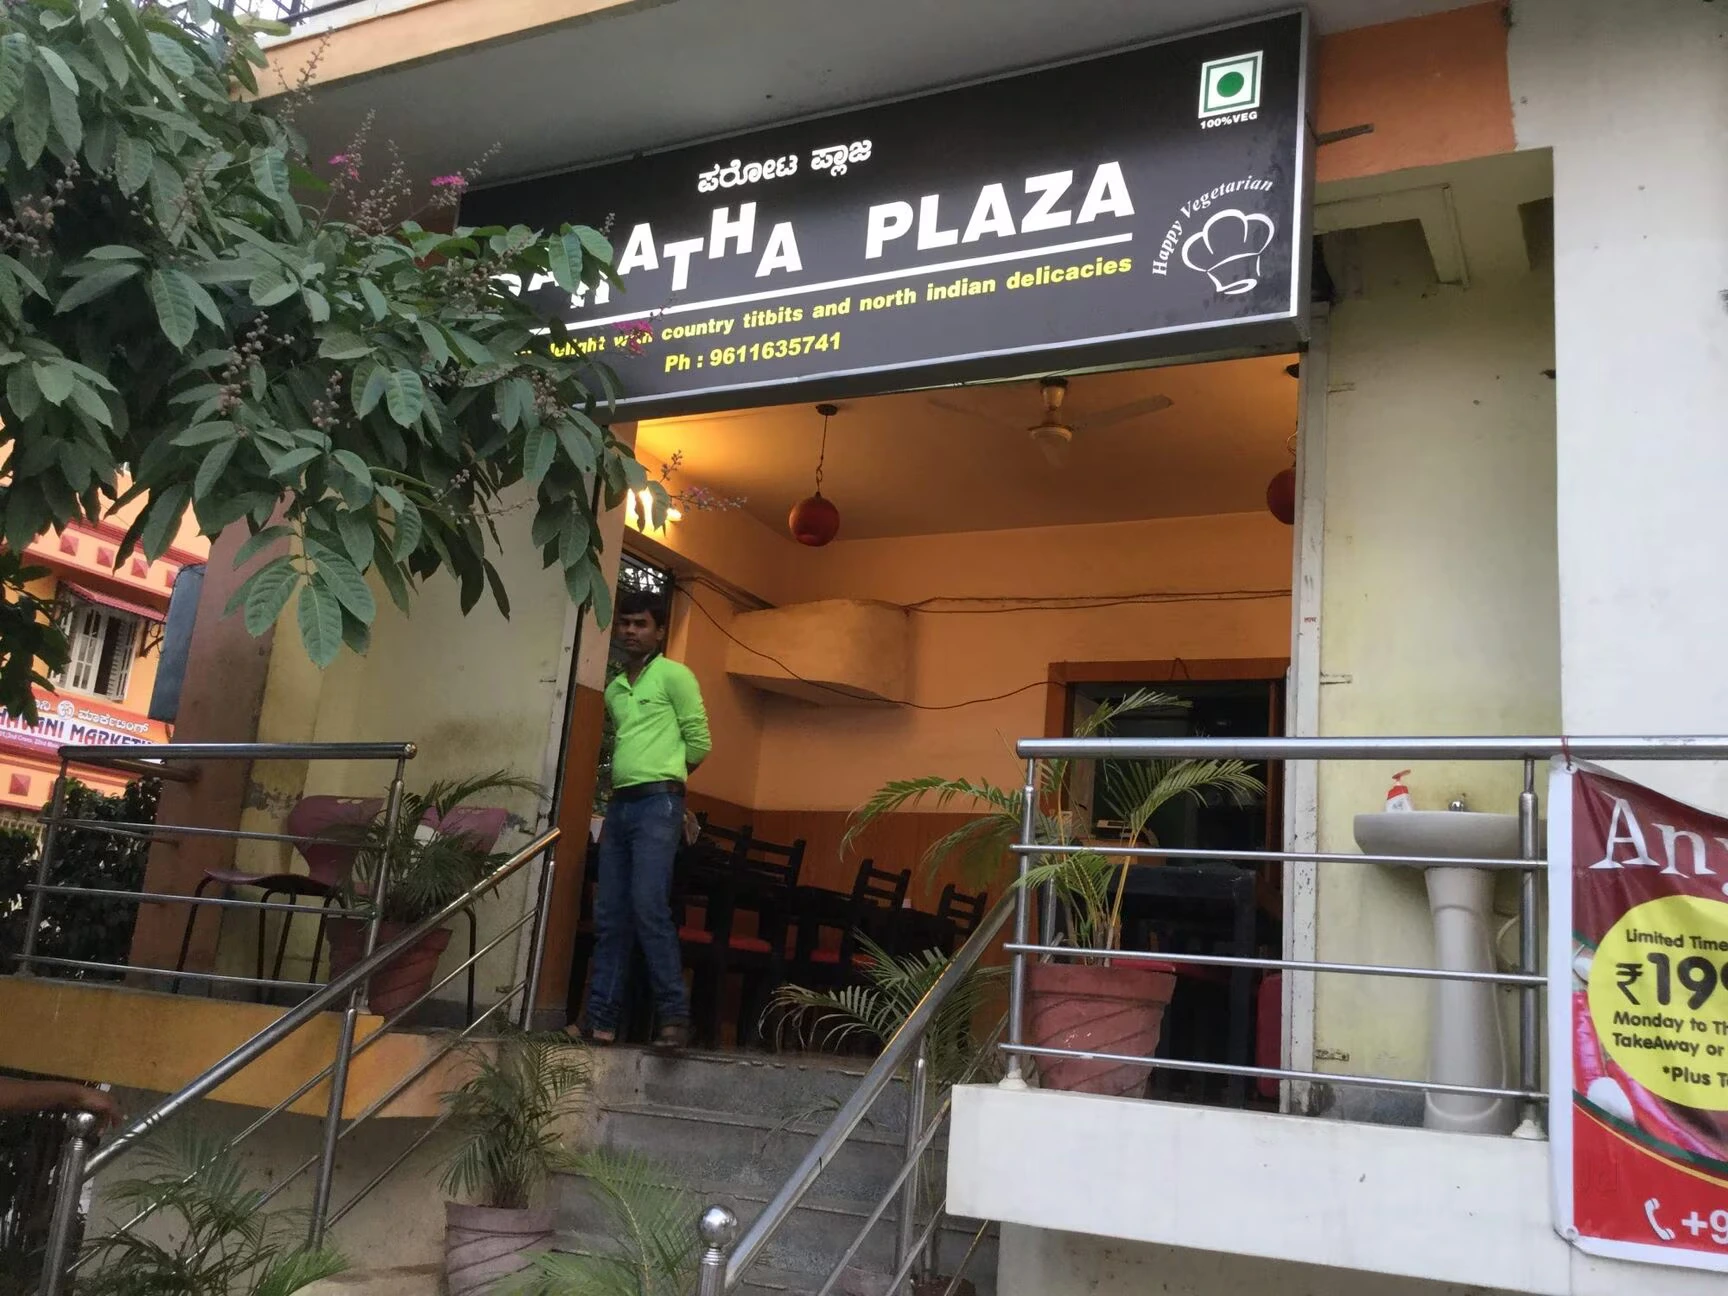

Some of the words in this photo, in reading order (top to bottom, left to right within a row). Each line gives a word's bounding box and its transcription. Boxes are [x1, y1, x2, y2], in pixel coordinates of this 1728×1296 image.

[1200, 111, 1258, 130] 100%VEG
[864, 161, 1136, 260] PLAZA
[1152, 220, 1183, 276] Happy
[1180, 175, 1274, 219] Vegetarian
[661, 317, 735, 341] country
[743, 306, 803, 329] titbits
[812, 297, 851, 319] and
[859, 287, 917, 312] north
[926, 274, 996, 301] indian
[1006, 254, 1133, 290] delicacies
[664, 353, 691, 373] Ph
[709, 331, 842, 367] 9611635741
[1626, 928, 1684, 948] Limited
[1689, 935, 1728, 952] Time
[1615, 952, 1728, 1011] ₹19
[1613, 1010, 1684, 1033] Monday
[1690, 1017, 1708, 1033] to
[1612, 1032, 1700, 1057] TakeAway
[1706, 1042, 1725, 1057] or
